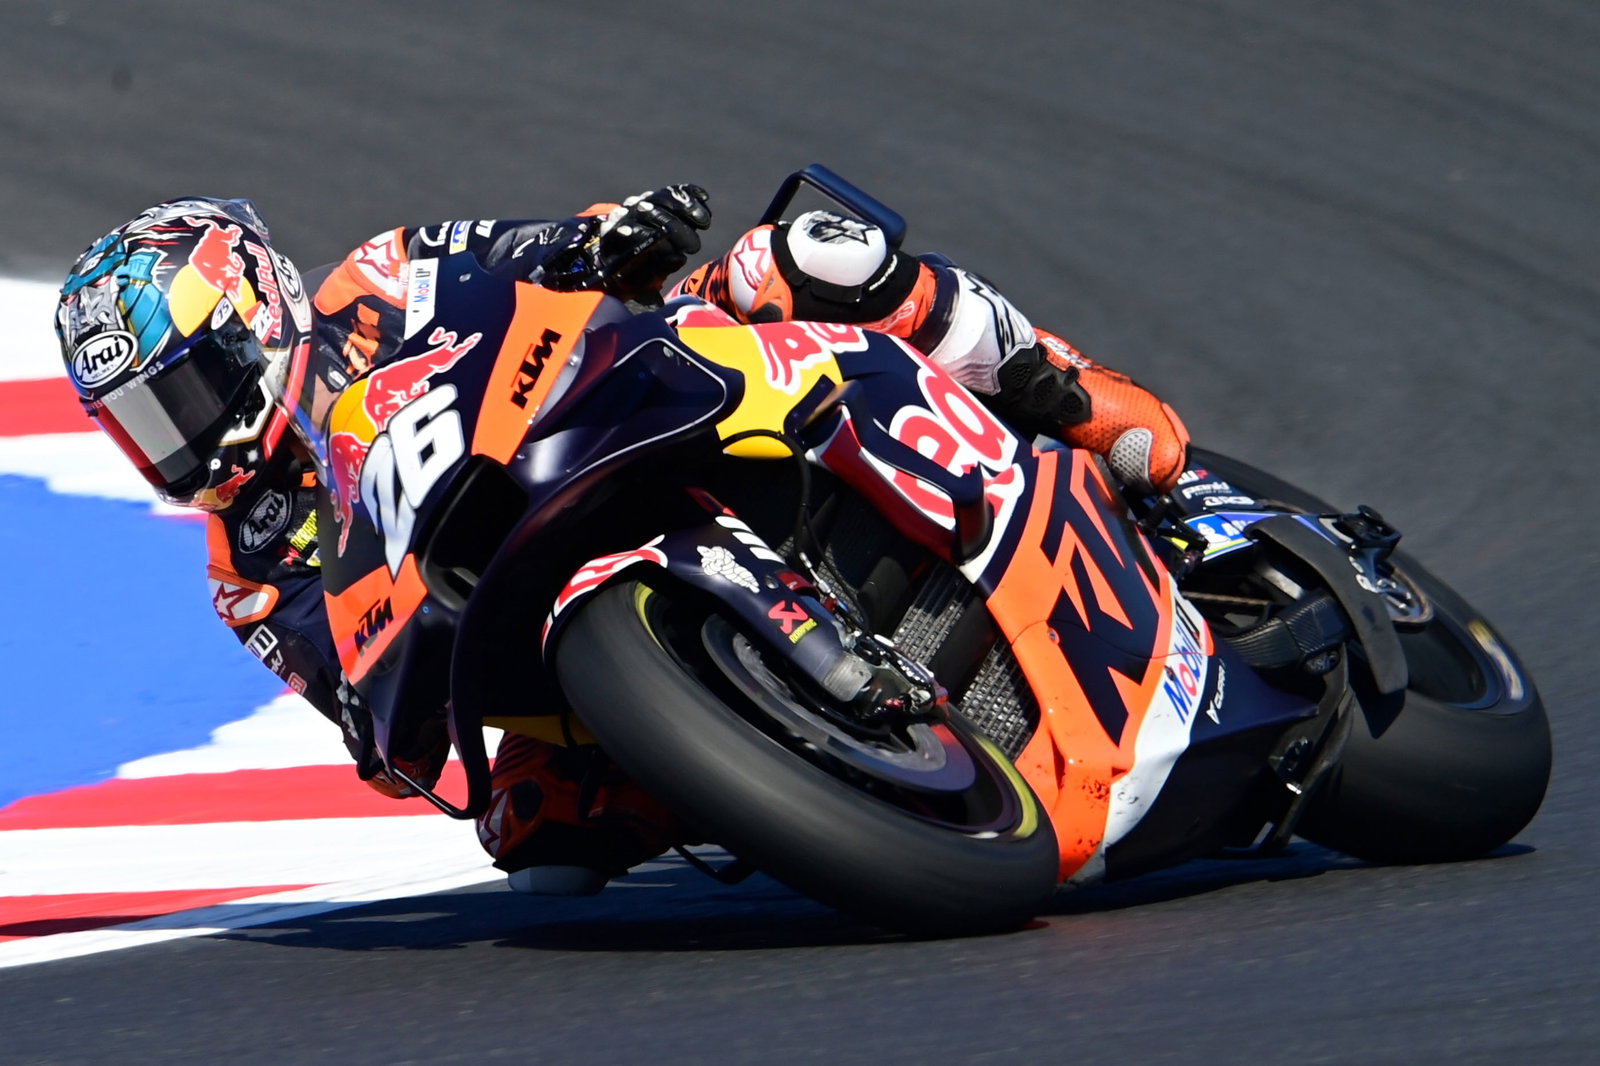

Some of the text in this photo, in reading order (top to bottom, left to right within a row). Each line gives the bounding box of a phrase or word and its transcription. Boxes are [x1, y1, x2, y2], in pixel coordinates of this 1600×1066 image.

[413, 279, 430, 303] Mobil
[79, 334, 125, 382] Arai
[104, 387, 125, 402] YOU
[126, 360, 165, 390] WINGS
[510, 328, 562, 410] KTM
[360, 384, 466, 585] 26
[249, 492, 285, 549] Arai
[354, 596, 395, 656] KTM
[1163, 620, 1203, 725] Mobil
